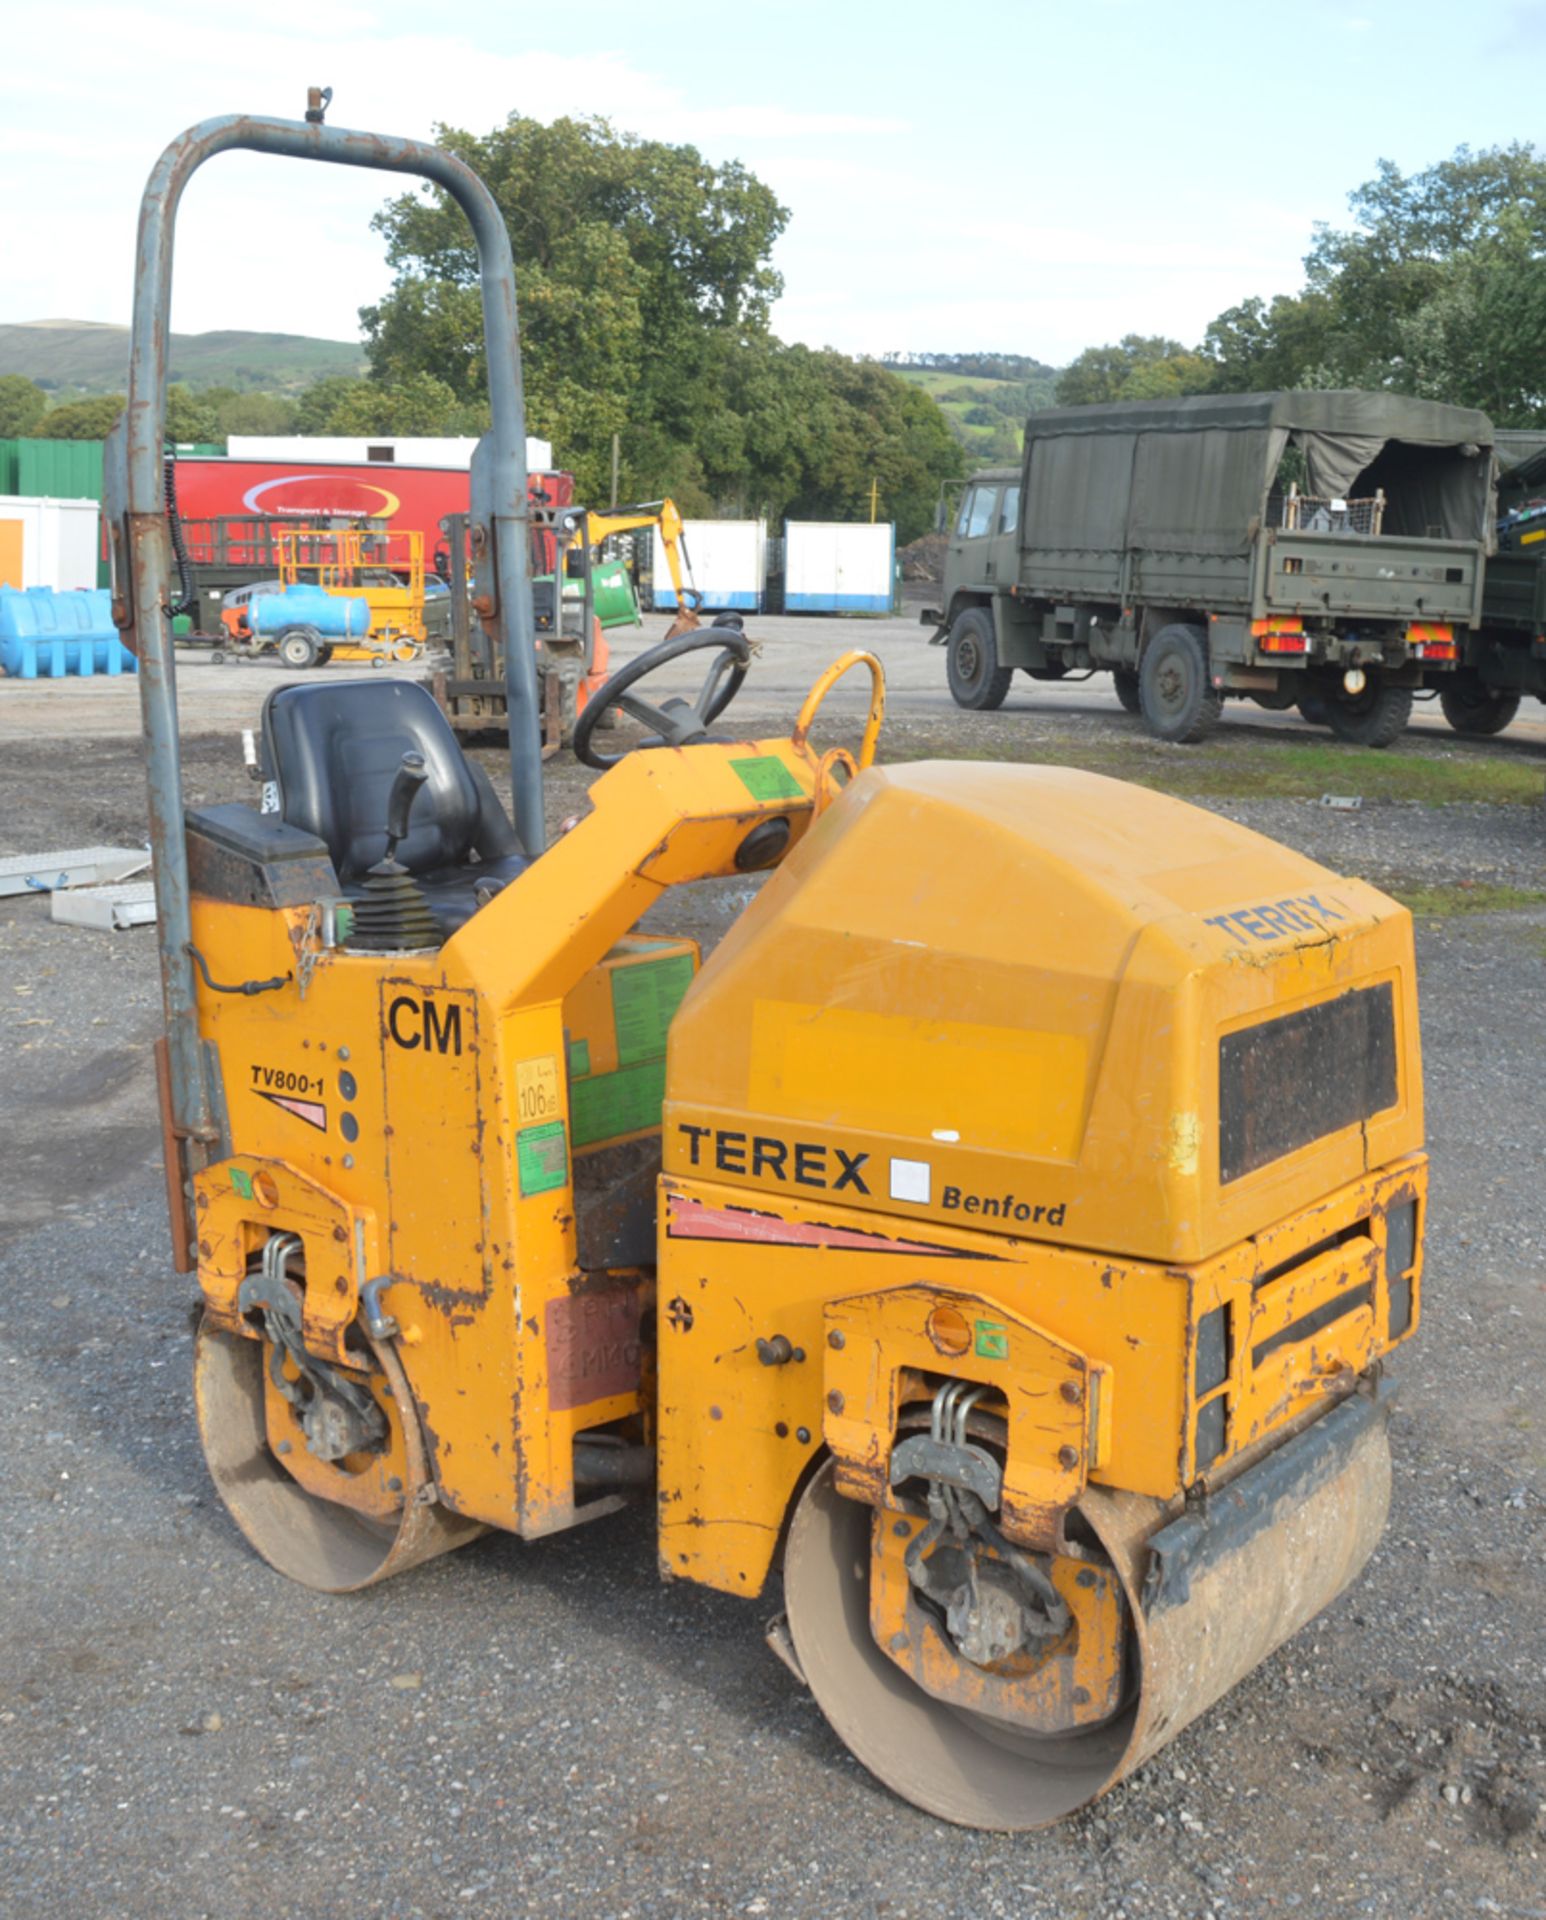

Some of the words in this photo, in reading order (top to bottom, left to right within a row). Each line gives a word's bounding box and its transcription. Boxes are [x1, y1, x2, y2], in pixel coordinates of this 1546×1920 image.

[276, 506, 321, 516] Transport
[333, 508, 368, 517] Storage
[1203, 894, 1345, 945] TEREX
[389, 996, 462, 1056] CM
[251, 1065, 324, 1096] TV800-1
[521, 1084, 546, 1117] 106
[678, 1124, 871, 1194] TEREX
[942, 1186, 1067, 1227] Benford
